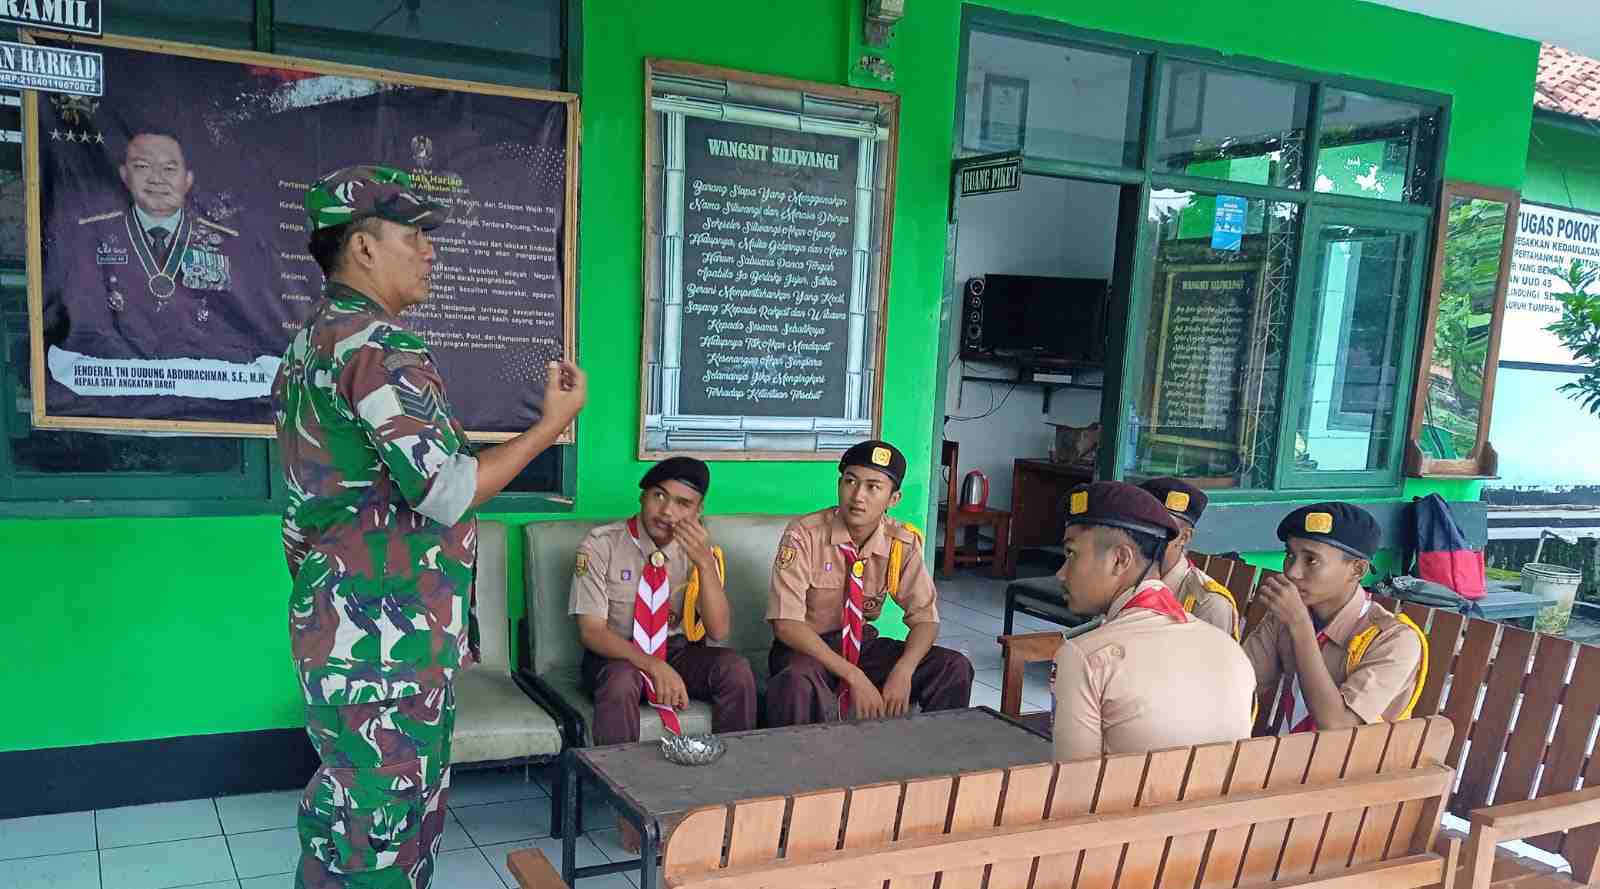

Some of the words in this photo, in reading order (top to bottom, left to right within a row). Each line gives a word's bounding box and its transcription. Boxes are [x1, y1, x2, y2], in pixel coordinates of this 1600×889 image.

[21, 48, 96, 78] HARKAD
[708, 139, 768, 161] WANGSIT
[772, 147, 839, 170] SILIWANGI
[431, 176, 462, 186] Harian
[964, 168, 990, 193] RUANG
[991, 165, 1017, 189] PIKET
[729, 184, 756, 198] Siapa
[758, 186, 785, 203] Yang
[689, 198, 720, 212] Nama
[722, 201, 762, 218] Siliwangi
[742, 220, 781, 236] Siliwangi
[1519, 210, 1554, 237] UGAS
[1556, 219, 1600, 244] POKOK
[808, 242, 823, 254] dan
[696, 266, 734, 281] Apabila
[1519, 263, 1536, 274] YANG
[534, 272, 555, 281] Negara
[1521, 275, 1540, 286] UUD
[1542, 279, 1553, 288] 45
[792, 290, 819, 305] Yang
[685, 300, 718, 315] Sayang
[720, 303, 757, 318] Kepada
[707, 319, 745, 333] Kepada
[74, 365, 114, 377] JENDERAL
[116, 366, 129, 378] TNI
[131, 367, 164, 379] DUDUNG
[74, 377, 99, 387] KEPALA
[101, 378, 117, 388] STAF
[118, 378, 153, 389] ANGKATAN
[154, 379, 176, 390] DARAT
